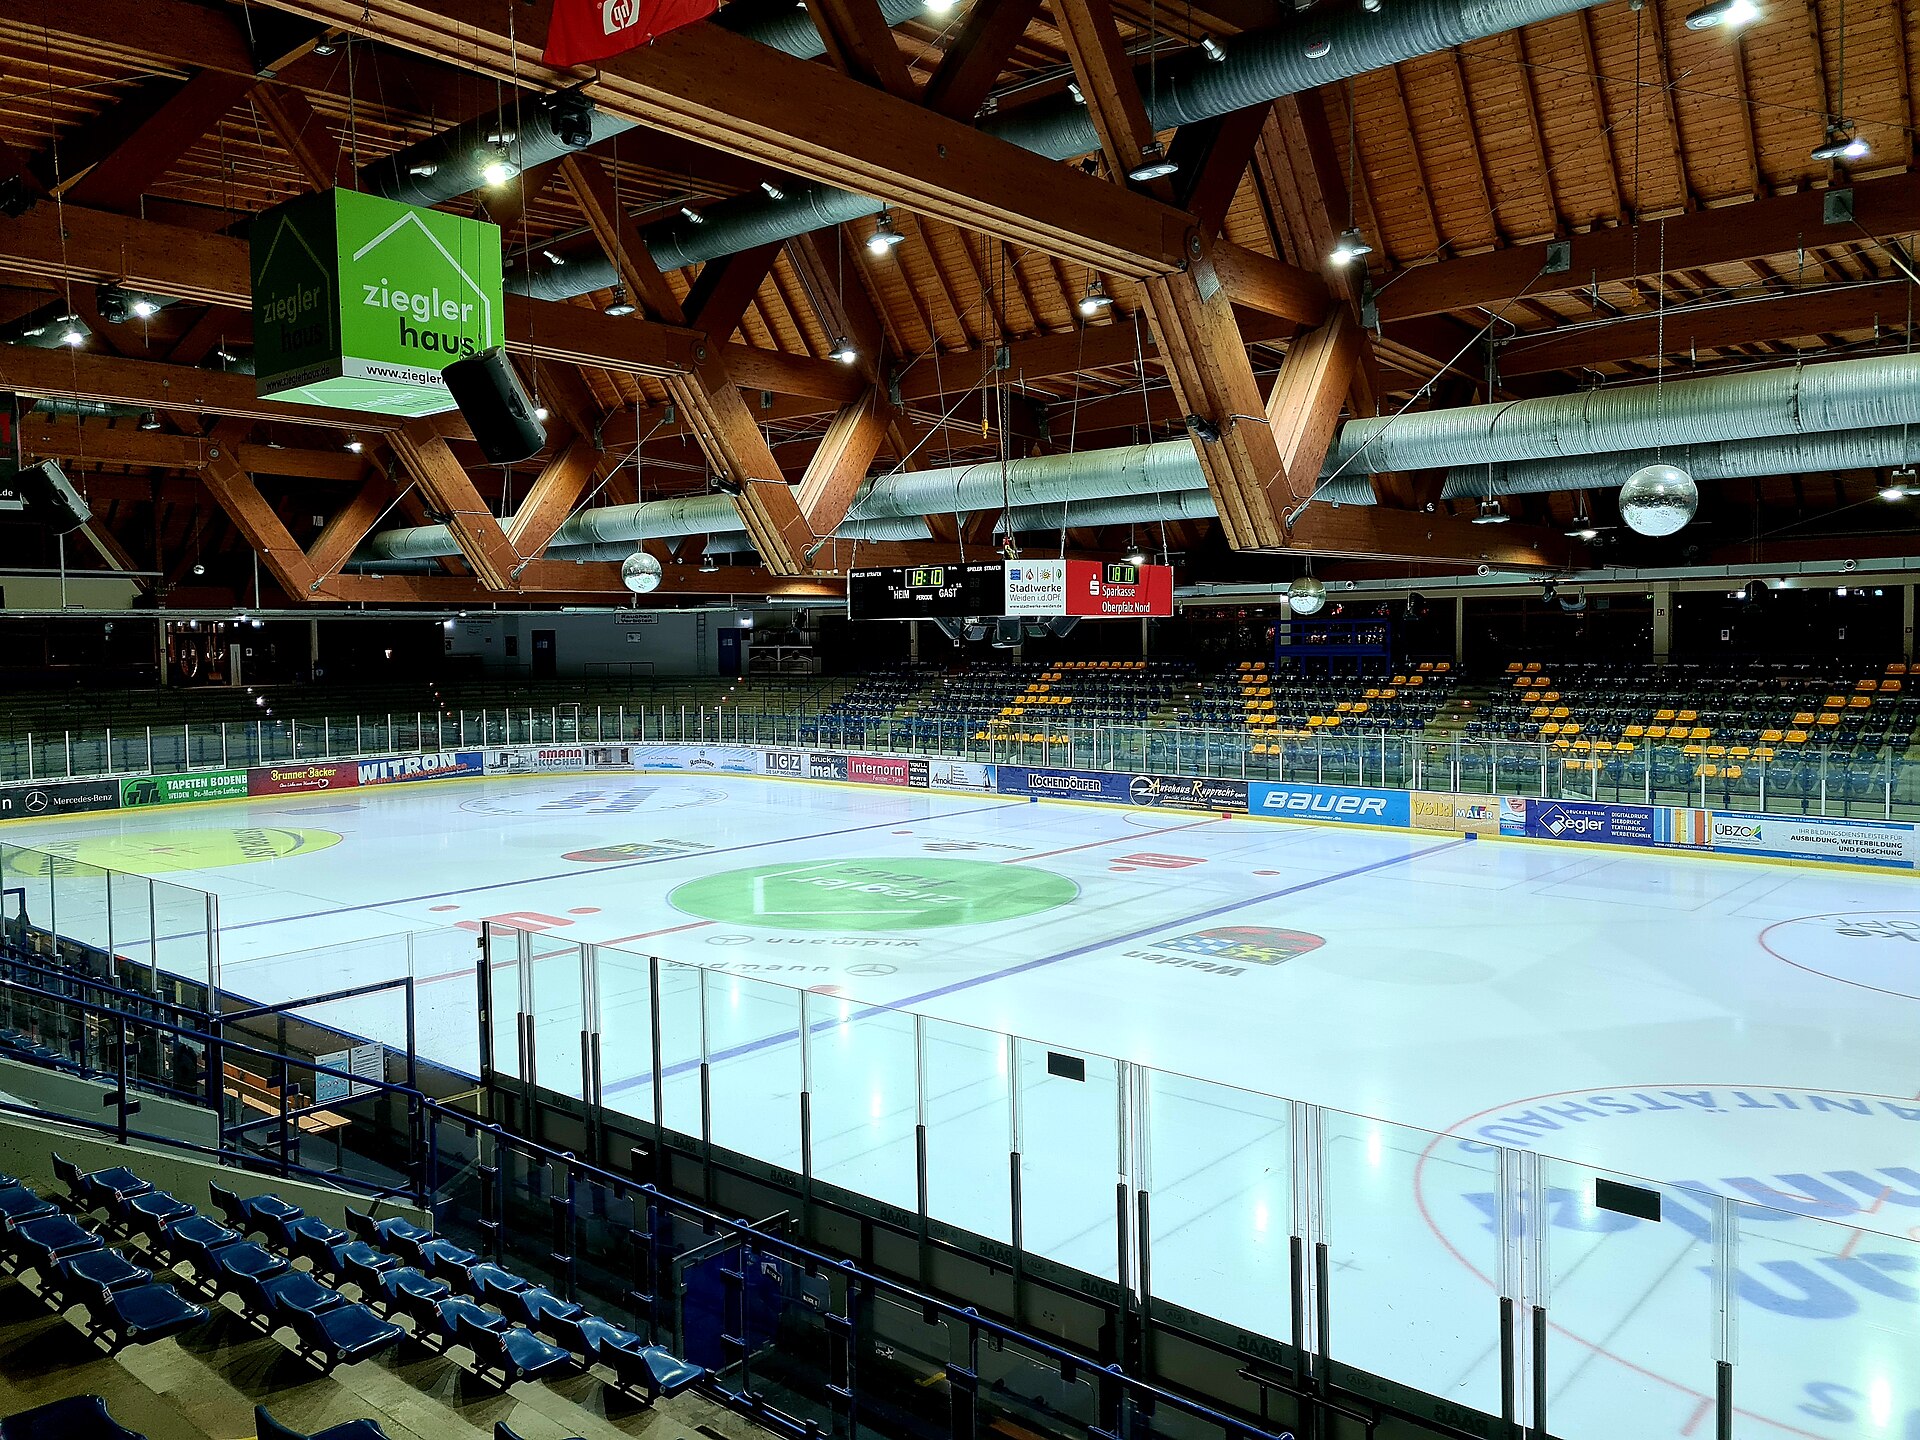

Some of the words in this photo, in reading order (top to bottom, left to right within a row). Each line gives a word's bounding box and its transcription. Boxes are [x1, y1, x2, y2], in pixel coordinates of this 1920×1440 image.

[263, 283, 321, 324] ziegler
[362, 278, 473, 323] ziegler
[280, 322, 323, 353] haus
[399, 317, 476, 357] haus
[912, 570, 942, 586] 18:10
[893, 589, 910, 600] HEIM
[938, 588, 958, 598] GAST
[1009, 583, 1062, 593] Stadtwerke
[1102, 585, 1136, 598] Sparkasse
[1009, 594, 1032, 602] Weiden
[1102, 601, 1134, 615] Oberpfalz
[1134, 602, 1150, 613] Nord
[538, 749, 582, 759] AMANN
[358, 753, 456, 784] WITRON
[768, 754, 801, 770] IGZ
[852, 761, 904, 777] Internorm
[271, 769, 307, 781] Brunner
[308, 767, 337, 779] Bäcker
[167, 778, 208, 790] TAPETEN
[1029, 774, 1101, 791] KOCHENDÖRFER
[1148, 778, 1190, 793] Autohaus
[1191, 780, 1236, 798] Rupprecht
[53, 793, 113, 806] Mercedes-Benz
[1263, 791, 1387, 816] BAUER
[1456, 808, 1494, 820] MALER
[1611, 812, 1649, 820] DIGITALDRUCK
[1555, 814, 1604, 834] Regler
[1611, 818, 1641, 826] SIEBDRUCK
[1611, 831, 1652, 839] WERBETECHNIK
[1790, 835, 1840, 845] AUSBILDUNG,
[1840, 838, 1903, 849] WEITERBILDUNG
[1811, 829, 1889, 840] BILDUNGSDIENSTLEISTER
[1890, 833, 1903, 841] FÜR
[1838, 845, 1855, 853] UND
[1855, 846, 1903, 857] FORSCHUNG
[1122, 951, 1248, 977] Weiden
